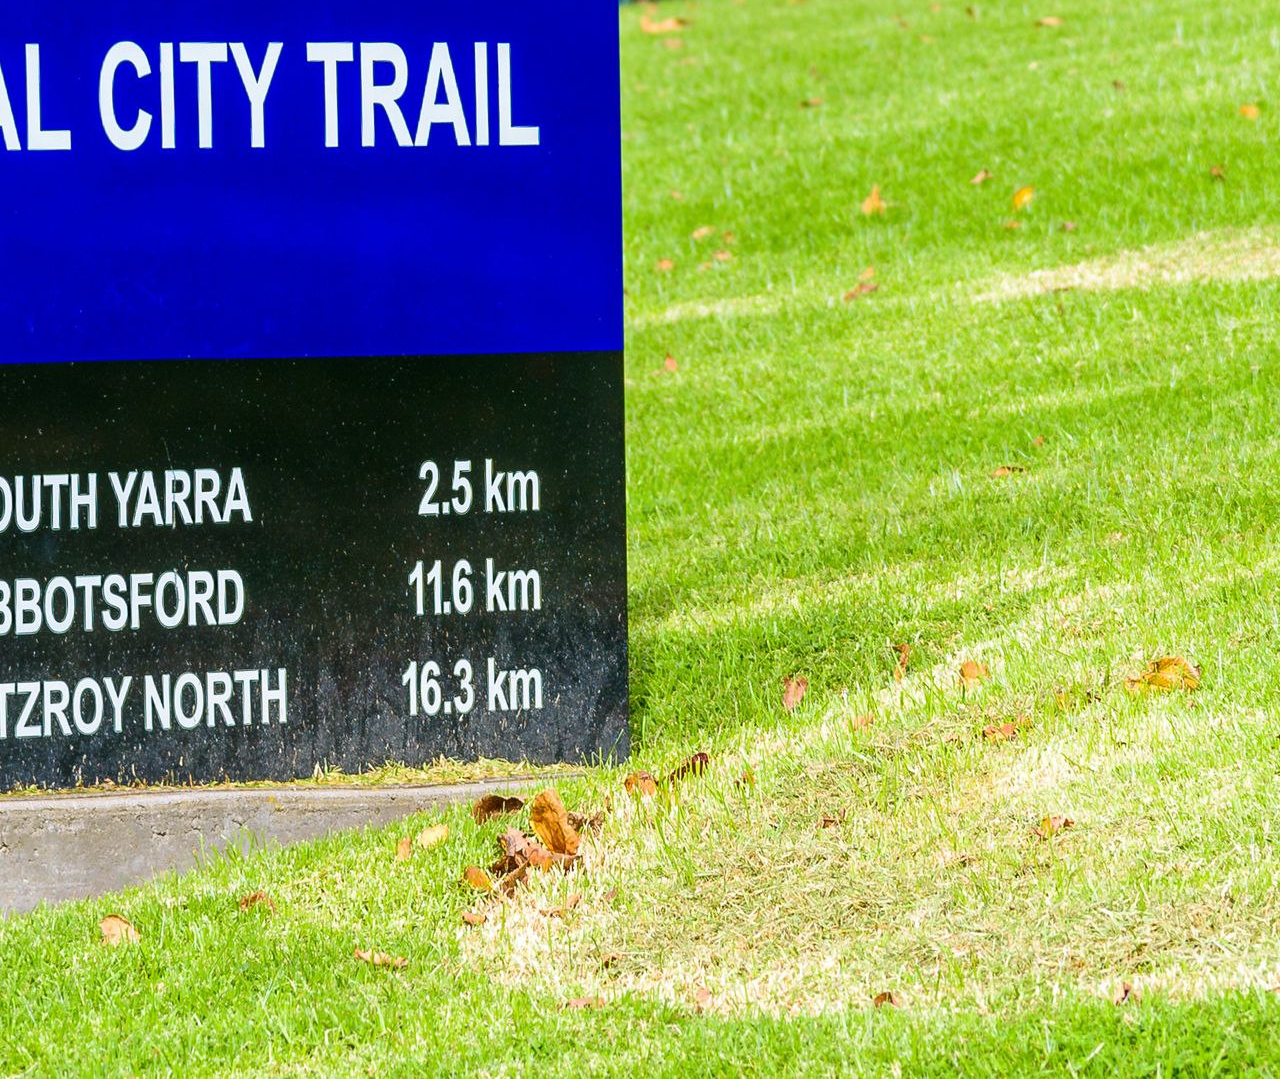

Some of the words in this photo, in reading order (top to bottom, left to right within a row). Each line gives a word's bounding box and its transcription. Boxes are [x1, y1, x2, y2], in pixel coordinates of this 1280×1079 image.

[99, 41, 283, 150] CITY
[307, 42, 539, 147] TRAIL
[110, 467, 252, 527] YARRA
[418, 460, 472, 515] 2.5
[485, 458, 540, 512] km
[408, 560, 472, 616] 11.6
[486, 558, 541, 612] km
[144, 667, 288, 730] NORTH
[402, 659, 476, 717] 16.3
[487, 657, 542, 712] km
